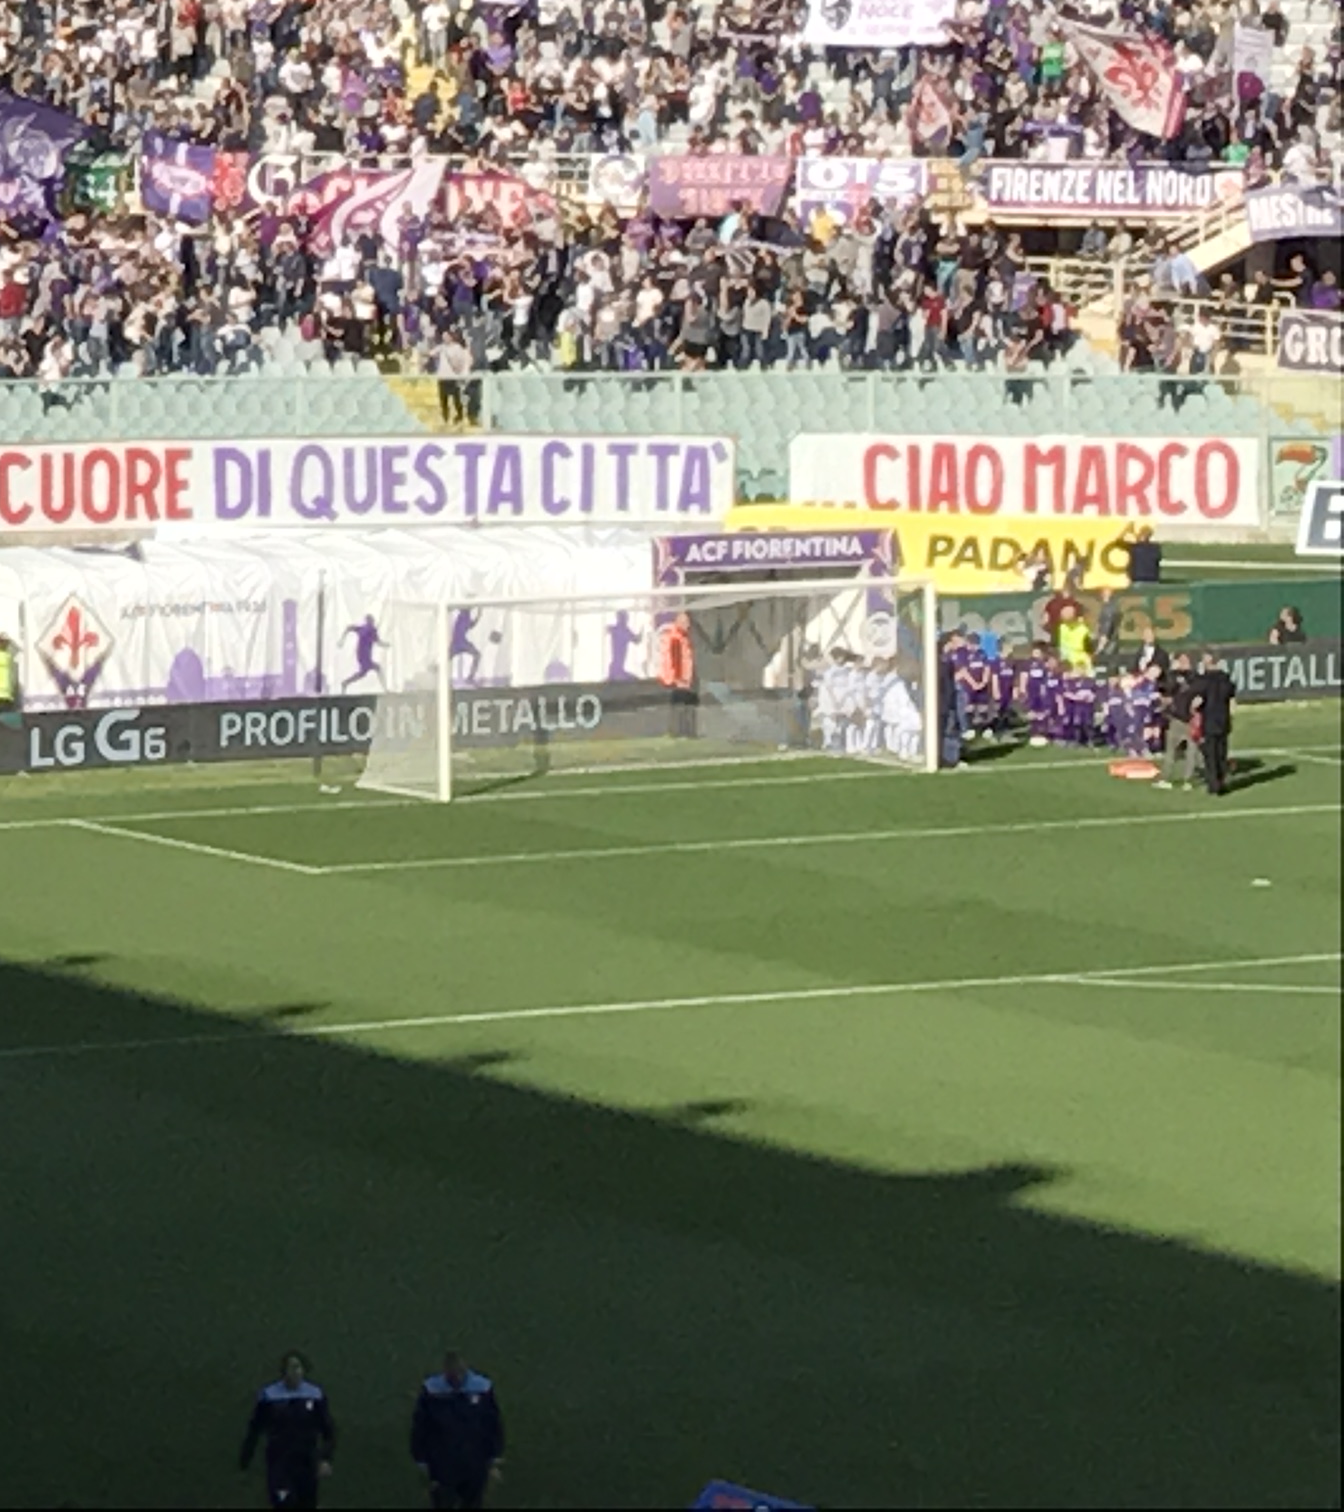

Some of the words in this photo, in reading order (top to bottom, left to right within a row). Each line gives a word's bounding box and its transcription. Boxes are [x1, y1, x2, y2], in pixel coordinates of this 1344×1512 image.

[990, 167, 1091, 205] FIRENZE
[1096, 168, 1141, 204] NEL
[1146, 170, 1212, 207] NORD
[213, 446, 273, 521] DI
[288, 441, 526, 523] QUESTA
[1022, 440, 1241, 520] MARCO
[684, 539, 728, 563] ACF
[732, 535, 865, 561] FIORENTINA
[31, 725, 85, 768] LG
[94, 709, 167, 762] G6
[218, 704, 373, 748] PROFILO
